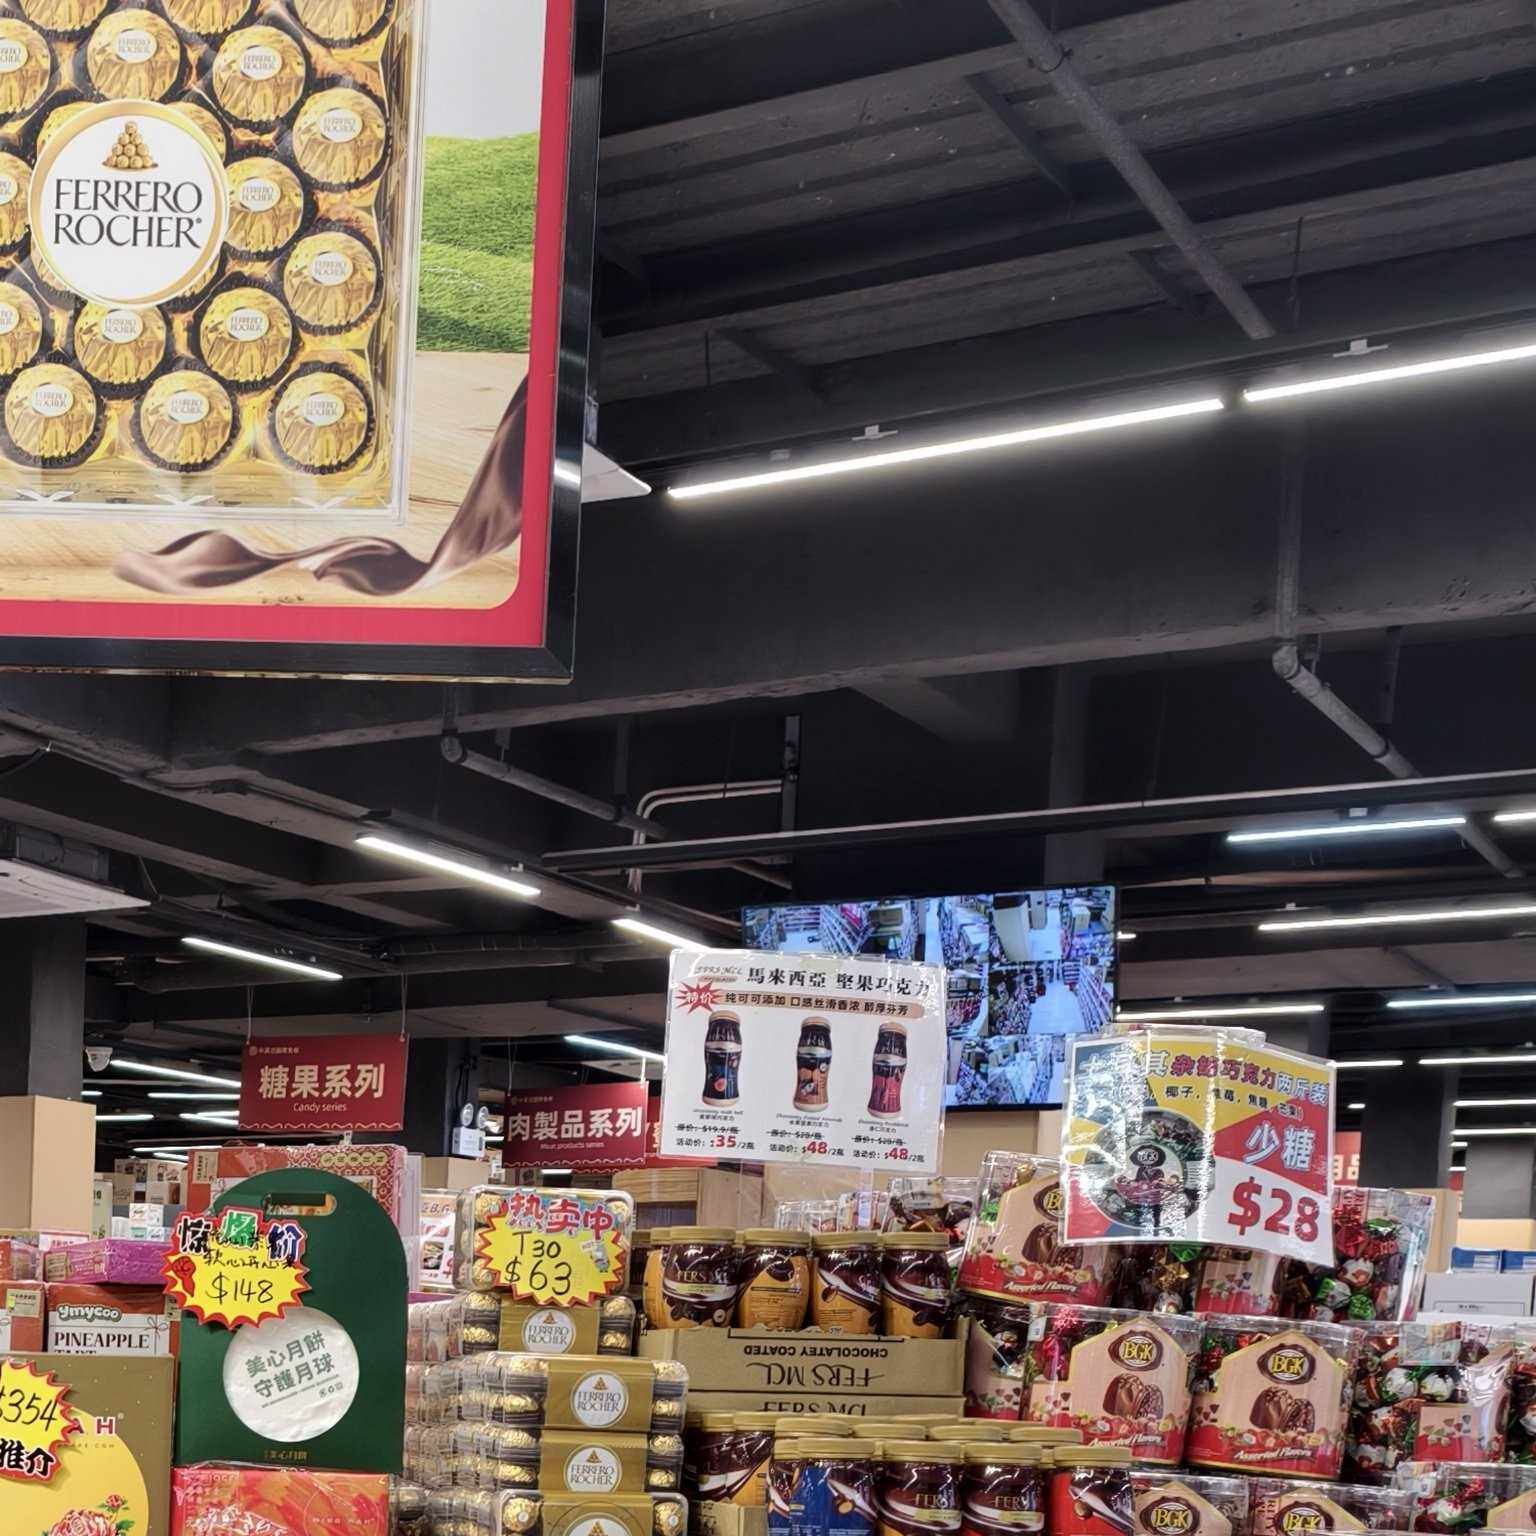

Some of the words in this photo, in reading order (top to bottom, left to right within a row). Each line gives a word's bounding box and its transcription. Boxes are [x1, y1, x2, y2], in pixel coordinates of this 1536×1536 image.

[55, 177, 203, 213] FERRERO
[53, 217, 202, 252] ROCHER
[747, 967, 827, 989] 馬來西亞
[258, 1063, 386, 1099] 糖果系列
[293, 1103, 320, 1113] Candy
[322, 1103, 347, 1112] series
[507, 1106, 644, 1142] 肉製品系列
[1243, 1120, 1315, 1171] 少糖
[508, 1189, 616, 1240] 热卖中
[1228, 1176, 1320, 1243] $28
[205, 1272, 274, 1305] $148
[504, 1257, 574, 1295] $63
[58, 1305, 120, 1321] ymycoo
[54, 1332, 150, 1349] PINEAPPLE
[526, 1327, 571, 1337] FERRERO
[526, 1337, 570, 1347] ROCHER
[246, 1330, 328, 1377] 美心月餅
[744, 1345, 796, 1356] COATED
[800, 1346, 888, 1358] CHOCOLATEY
[254, 1353, 336, 1398] 守護月球
